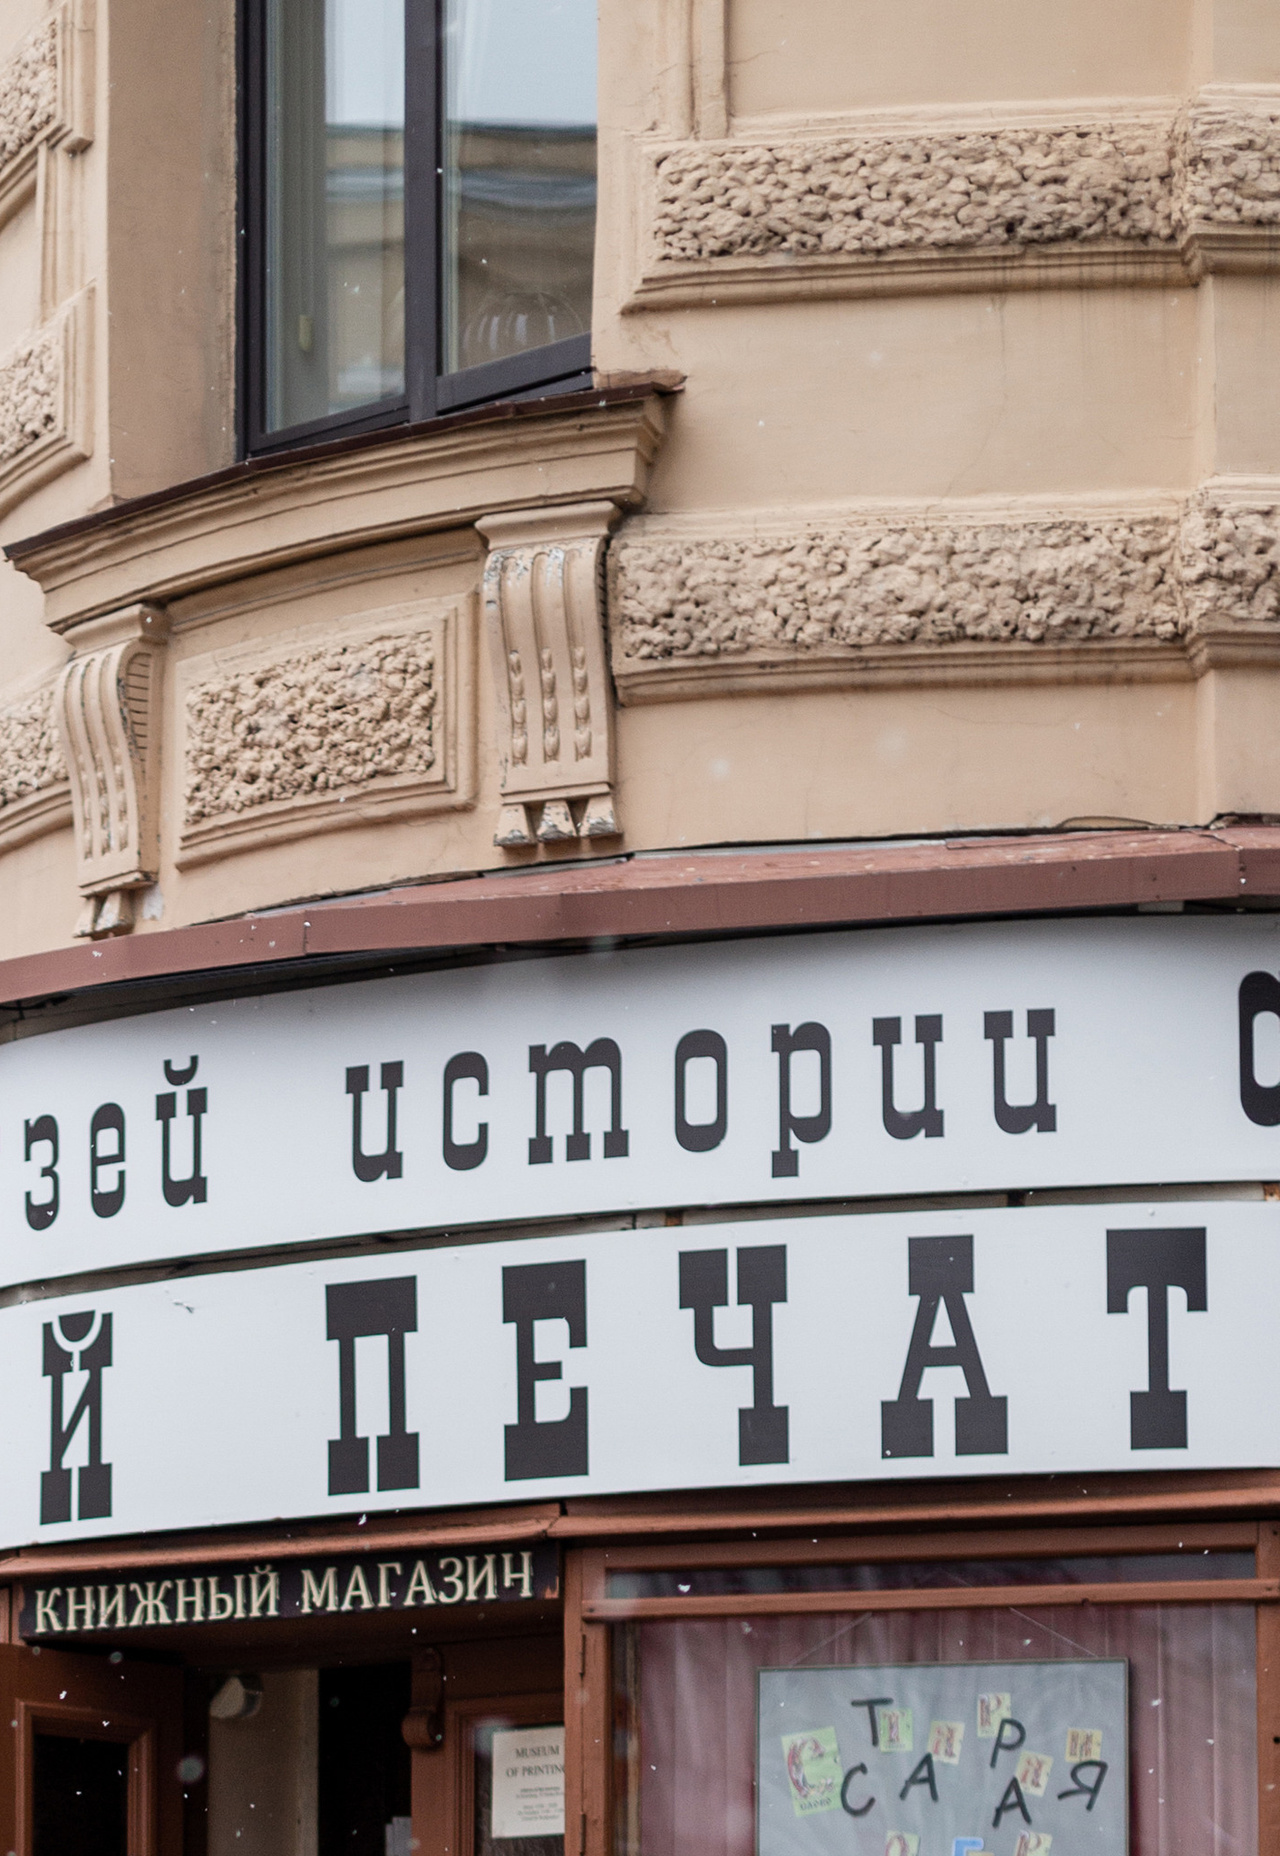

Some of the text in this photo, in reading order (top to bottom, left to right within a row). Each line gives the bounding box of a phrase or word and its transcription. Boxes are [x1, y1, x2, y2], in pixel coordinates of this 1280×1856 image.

[345, 1008, 1057, 1182] истории
[325, 1227, 1208, 1496] ПЕЧАТ
[35, 1551, 533, 1633] КНИЖНЫЙ МАГАЗИН
[506, 1766, 519, 1777] OF
[515, 1744, 560, 1758] MUSEUM
